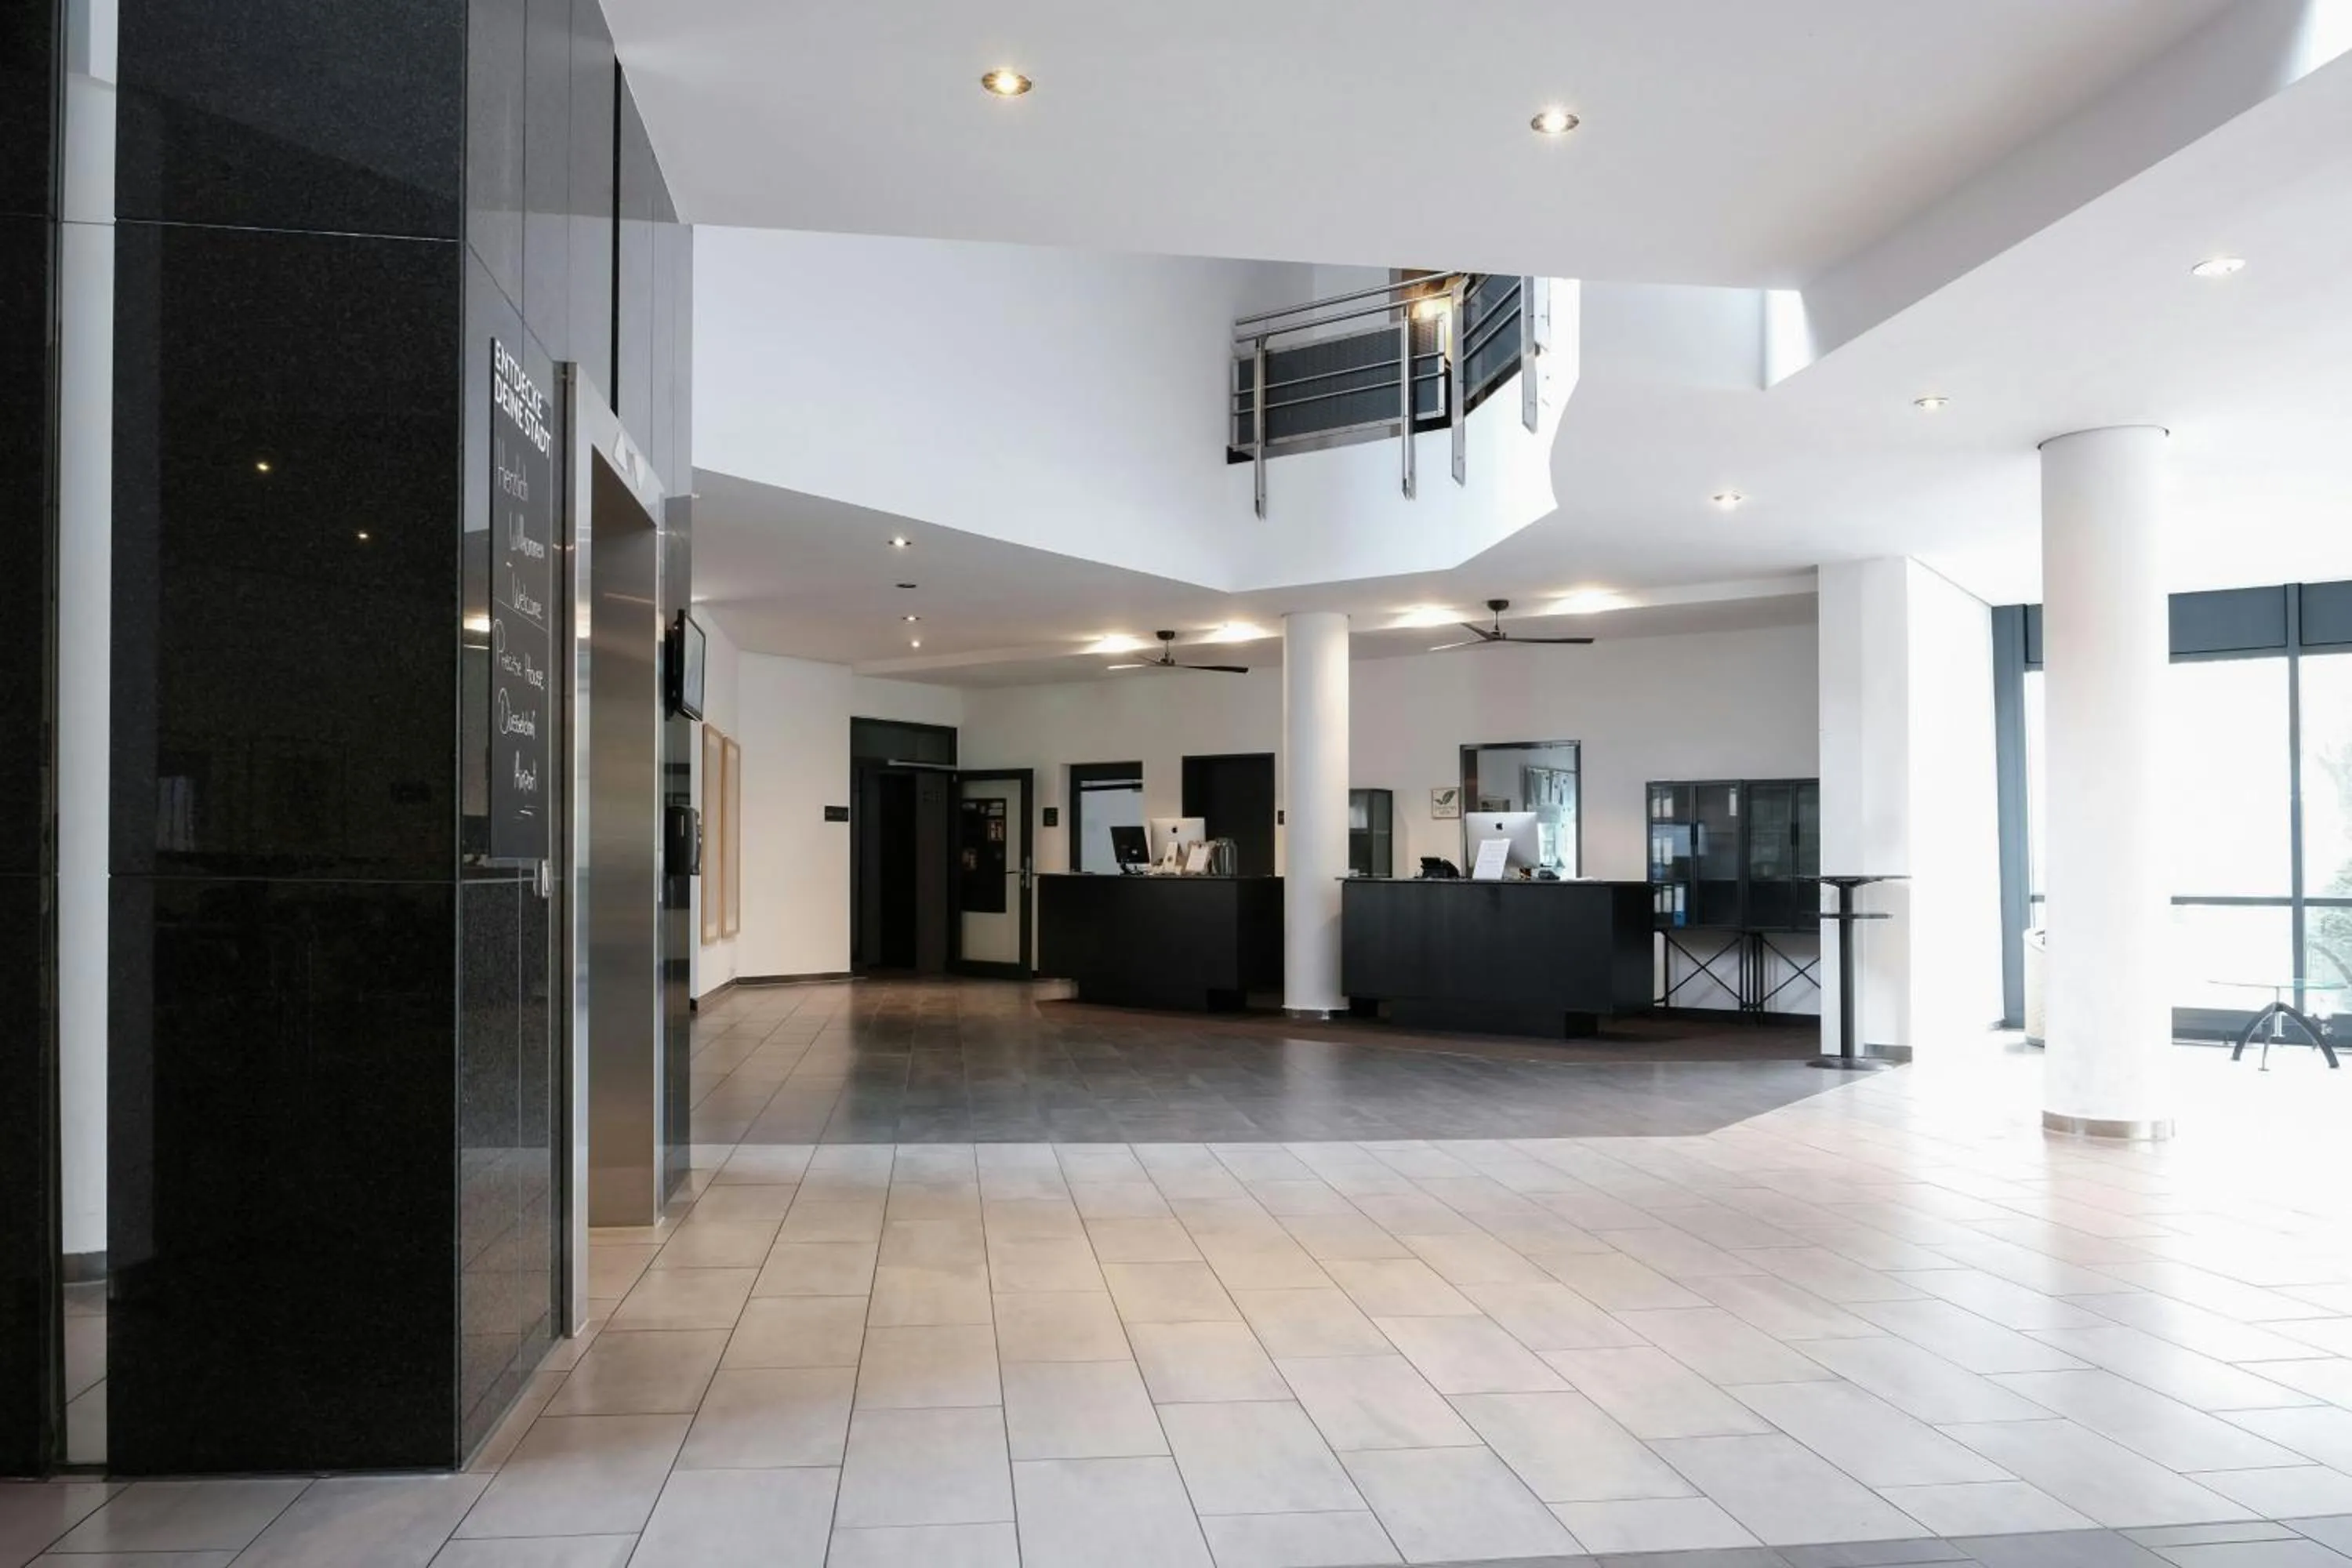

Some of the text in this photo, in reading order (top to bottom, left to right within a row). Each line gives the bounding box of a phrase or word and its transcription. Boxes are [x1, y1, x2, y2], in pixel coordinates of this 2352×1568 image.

[495, 339, 543, 419] ENTDECKE
[495, 372, 551, 459] DEINE STADT
